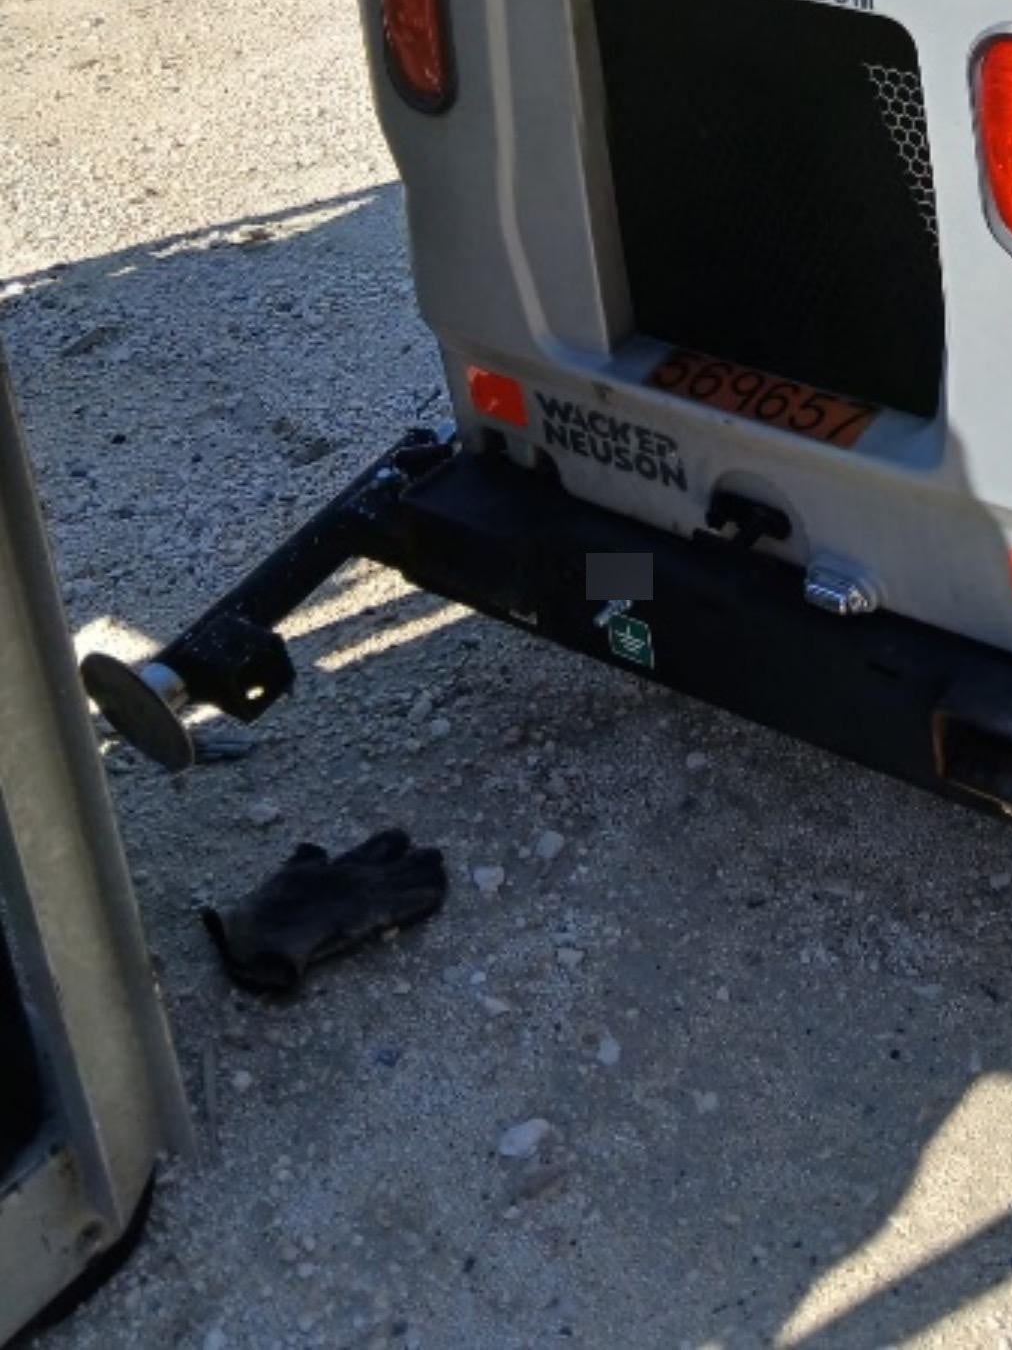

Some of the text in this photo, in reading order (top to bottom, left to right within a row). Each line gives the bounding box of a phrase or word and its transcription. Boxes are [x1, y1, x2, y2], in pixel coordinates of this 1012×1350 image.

[536, 391, 678, 457] WACKER
[648, 351, 872, 444] 569657
[543, 418, 688, 492] NEUSON
